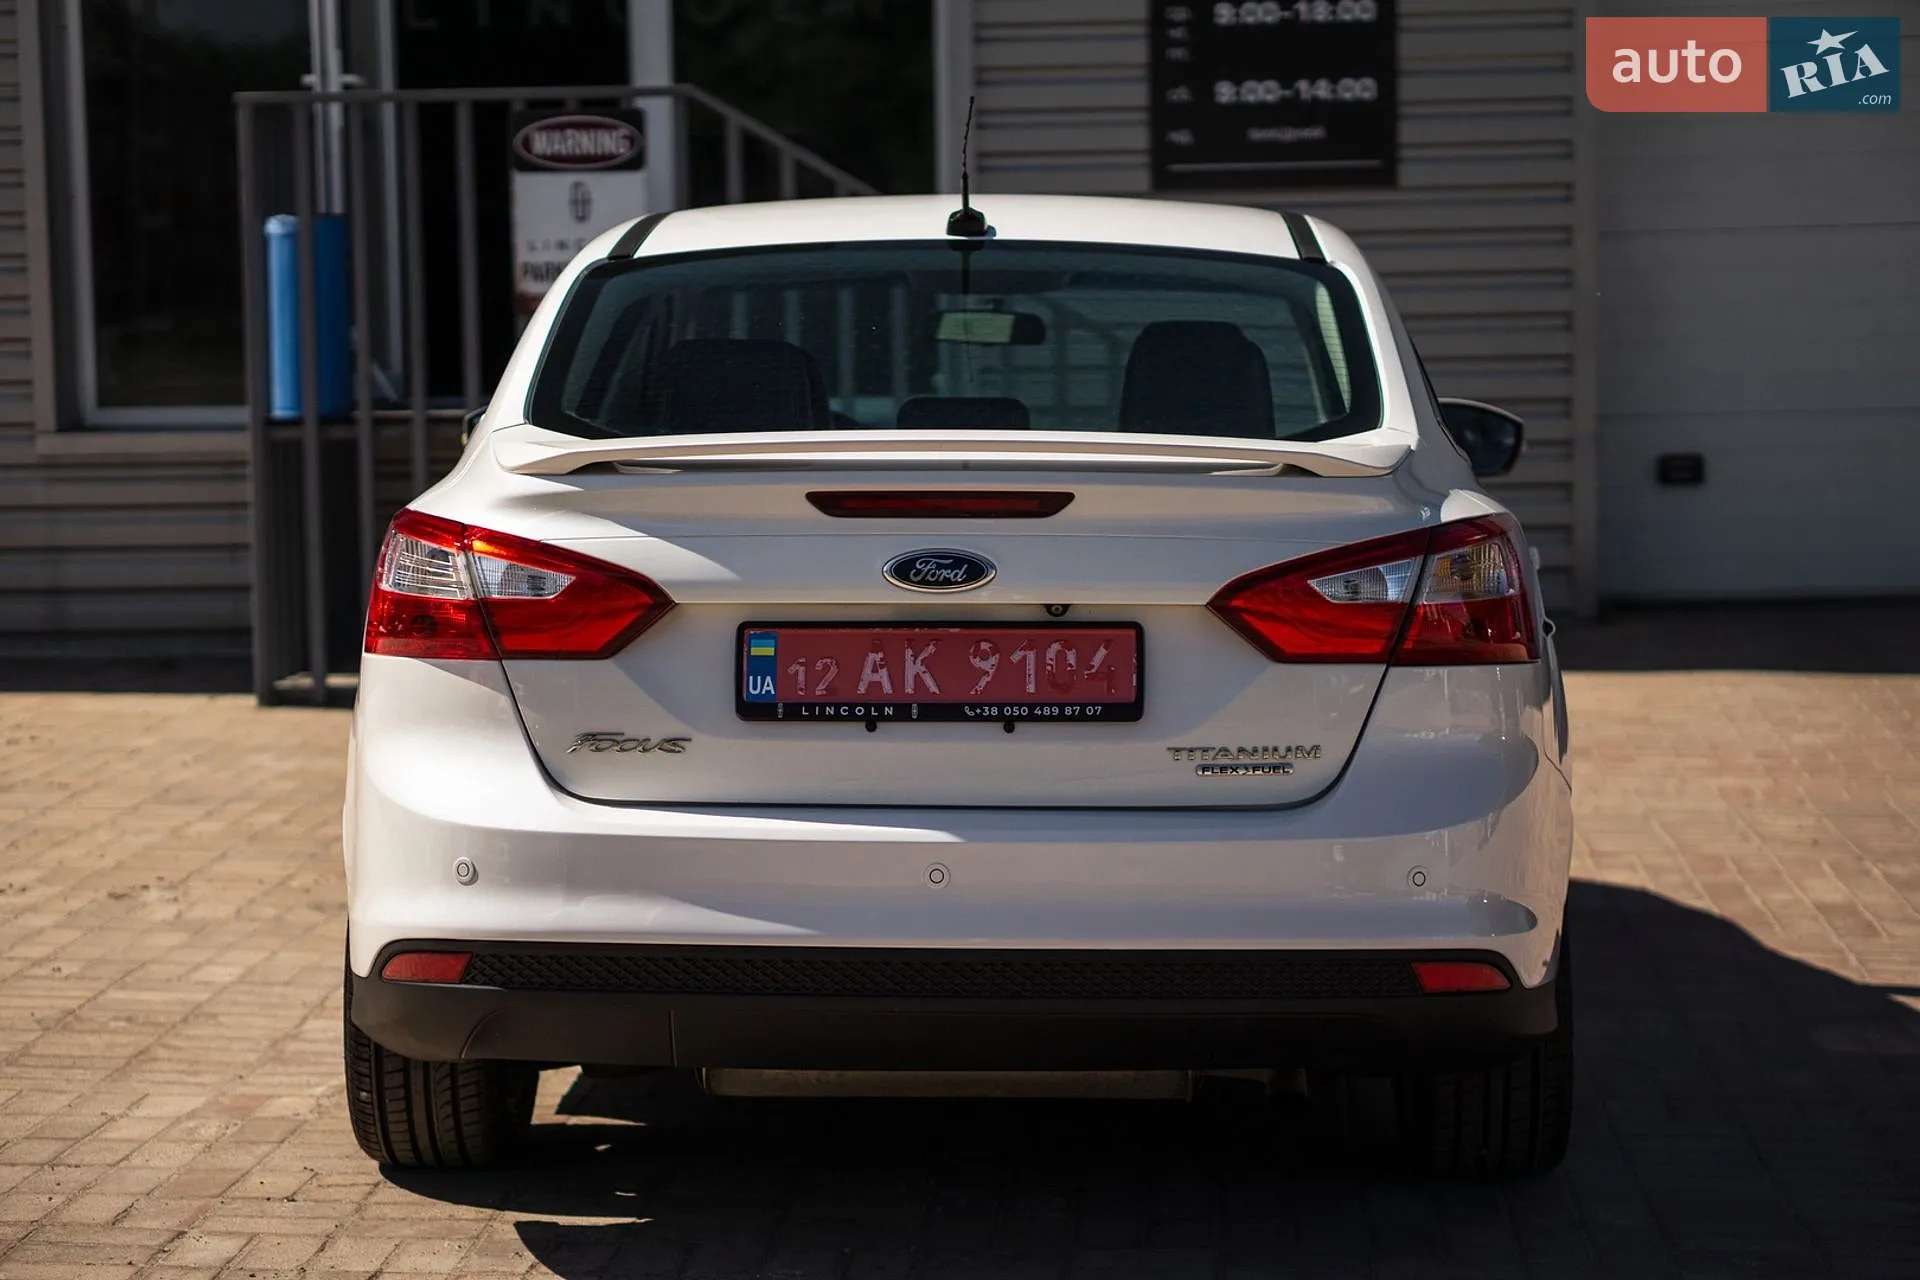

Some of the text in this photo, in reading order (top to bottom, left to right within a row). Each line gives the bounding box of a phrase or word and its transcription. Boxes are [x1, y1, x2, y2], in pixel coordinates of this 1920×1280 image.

[1213, 77, 1379, 105] 9:00-14:00
[532, 128, 632, 156] WARNING
[908, 557, 969, 582] Ford
[786, 638, 1115, 696] 12 AK 9104
[748, 676, 776, 695] UA
[802, 706, 894, 716] LINCOLN
[975, 706, 1103, 716] +38 050 489 87 07
[1166, 744, 1322, 761] TITANIUM
